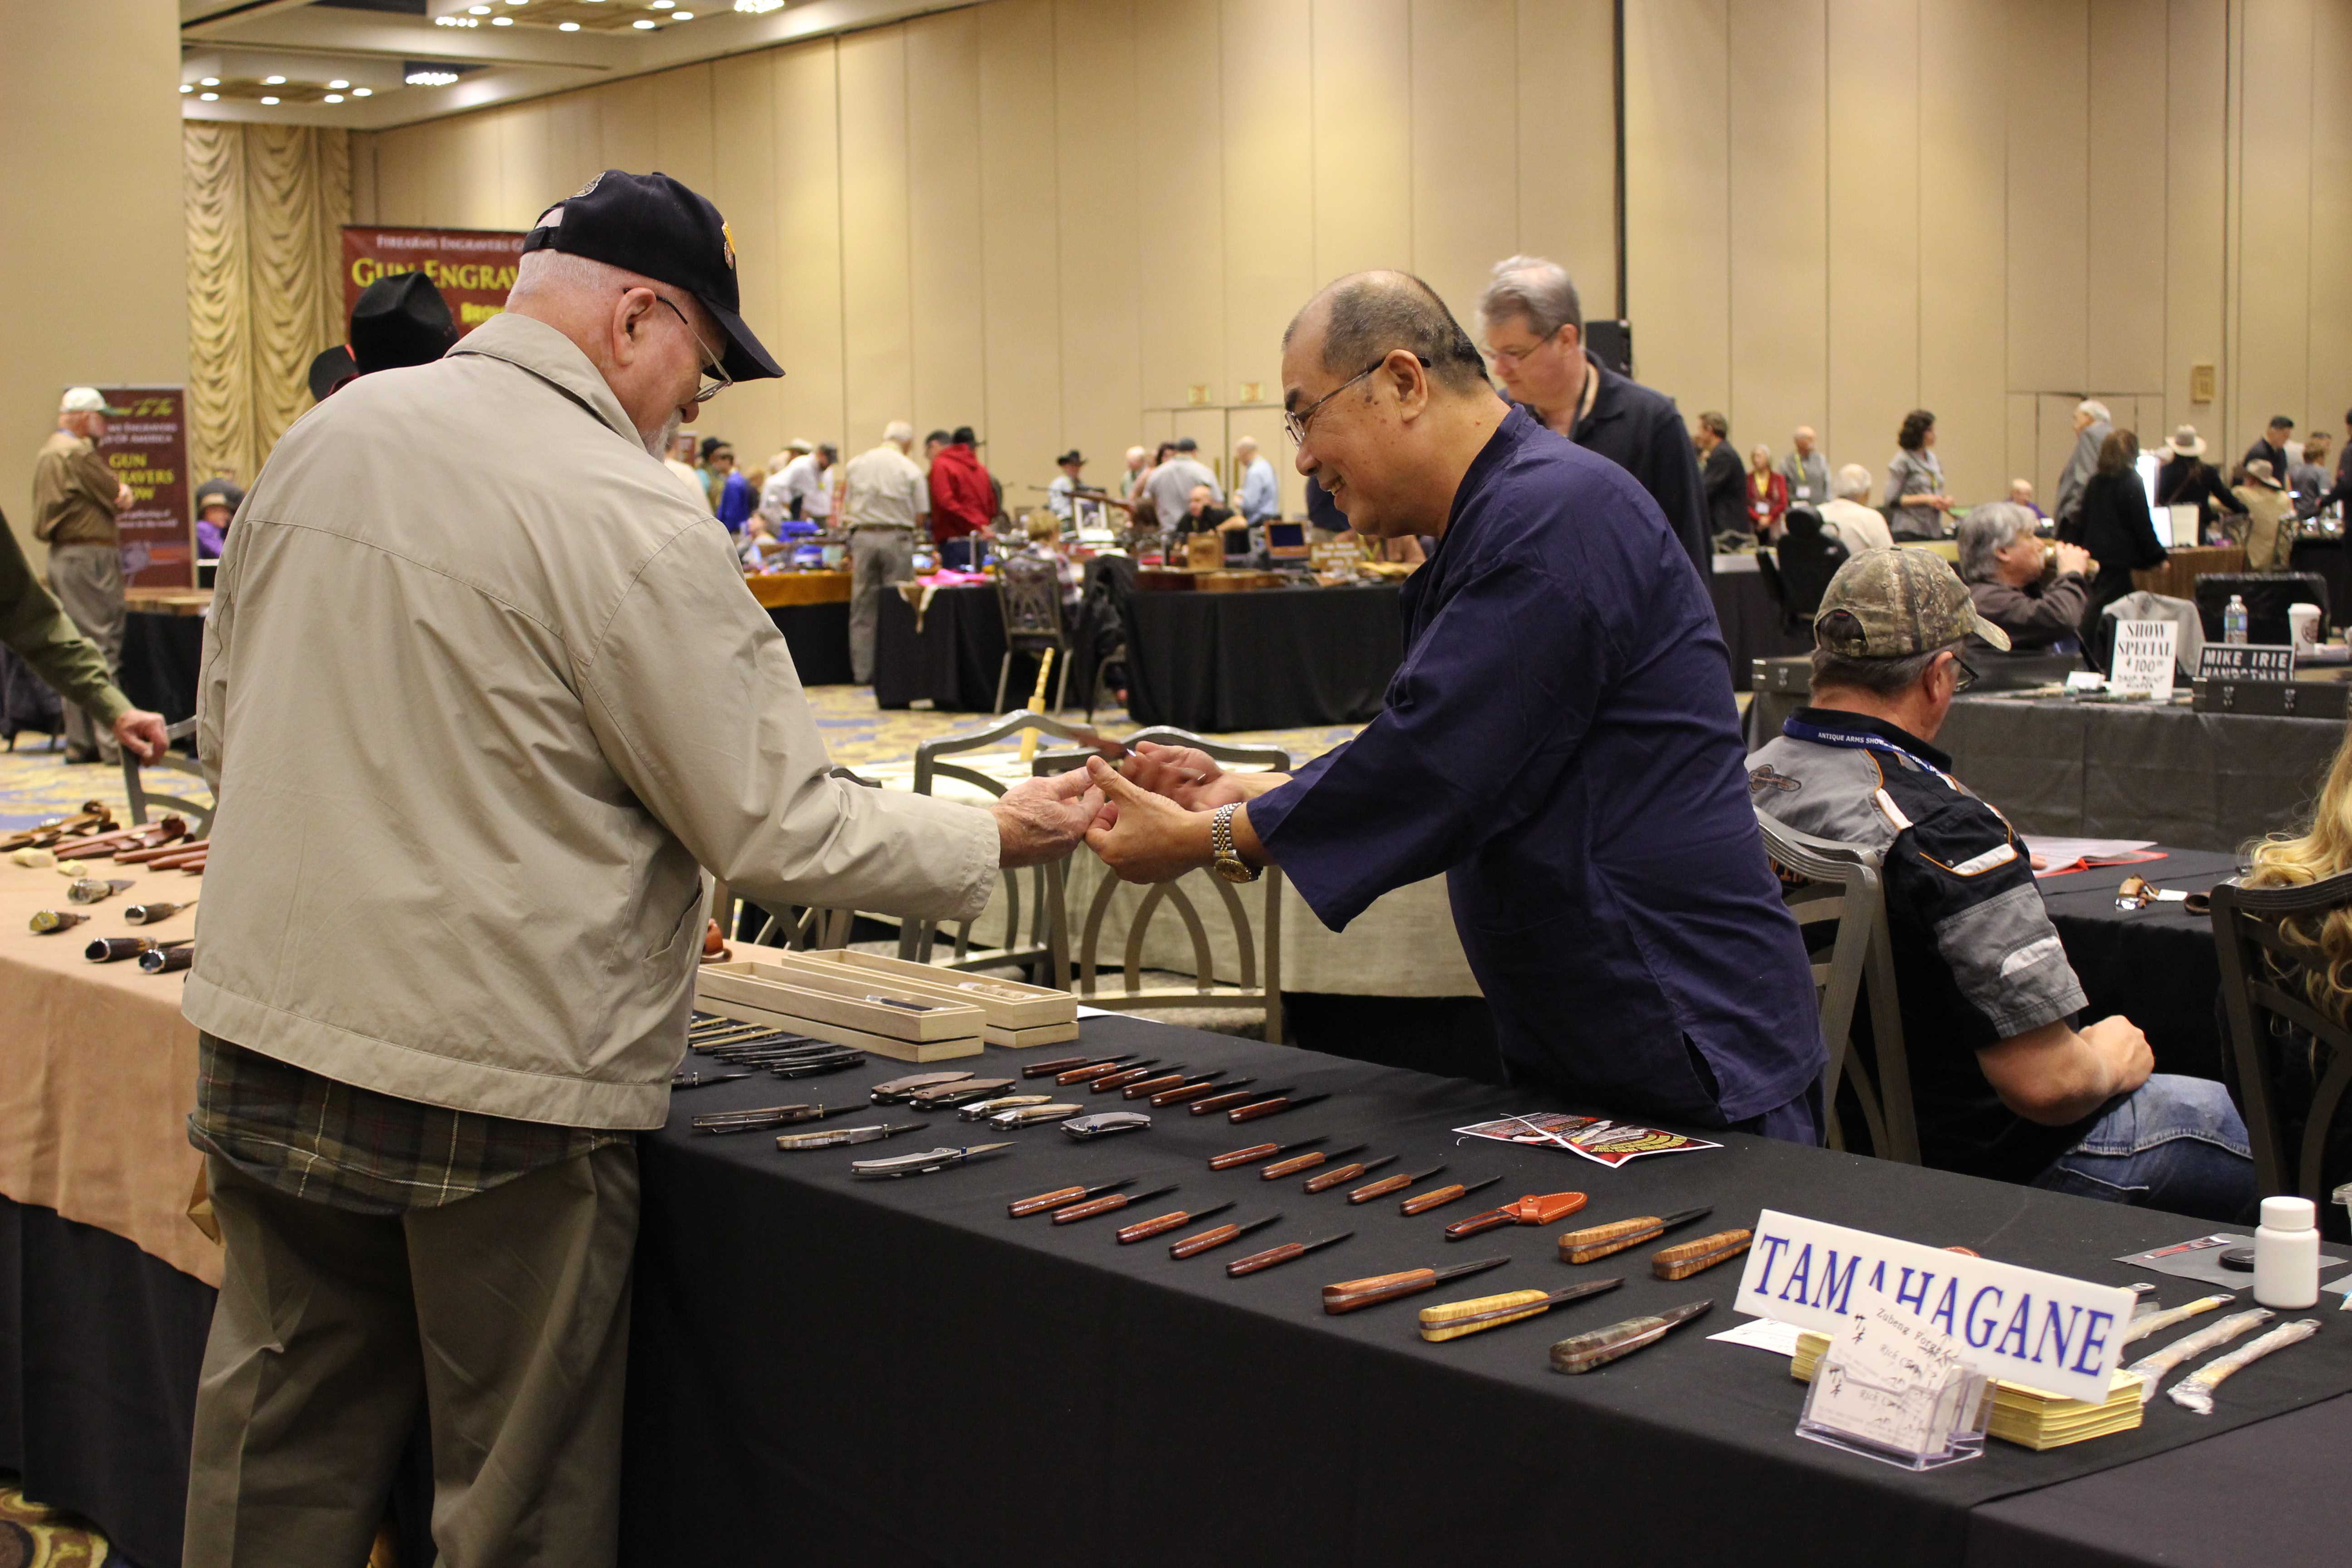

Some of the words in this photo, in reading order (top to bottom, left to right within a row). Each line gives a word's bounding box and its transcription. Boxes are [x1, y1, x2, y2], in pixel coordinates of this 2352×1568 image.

[109, 453, 147, 468] GUN
[2127, 623, 2165, 637] SHOW
[2117, 641, 2173, 657] SPECIAL
[2203, 649, 2243, 666] MIKE
[2251, 651, 2289, 668] IRIE
[1818, 732, 1844, 742] ANTIQUE
